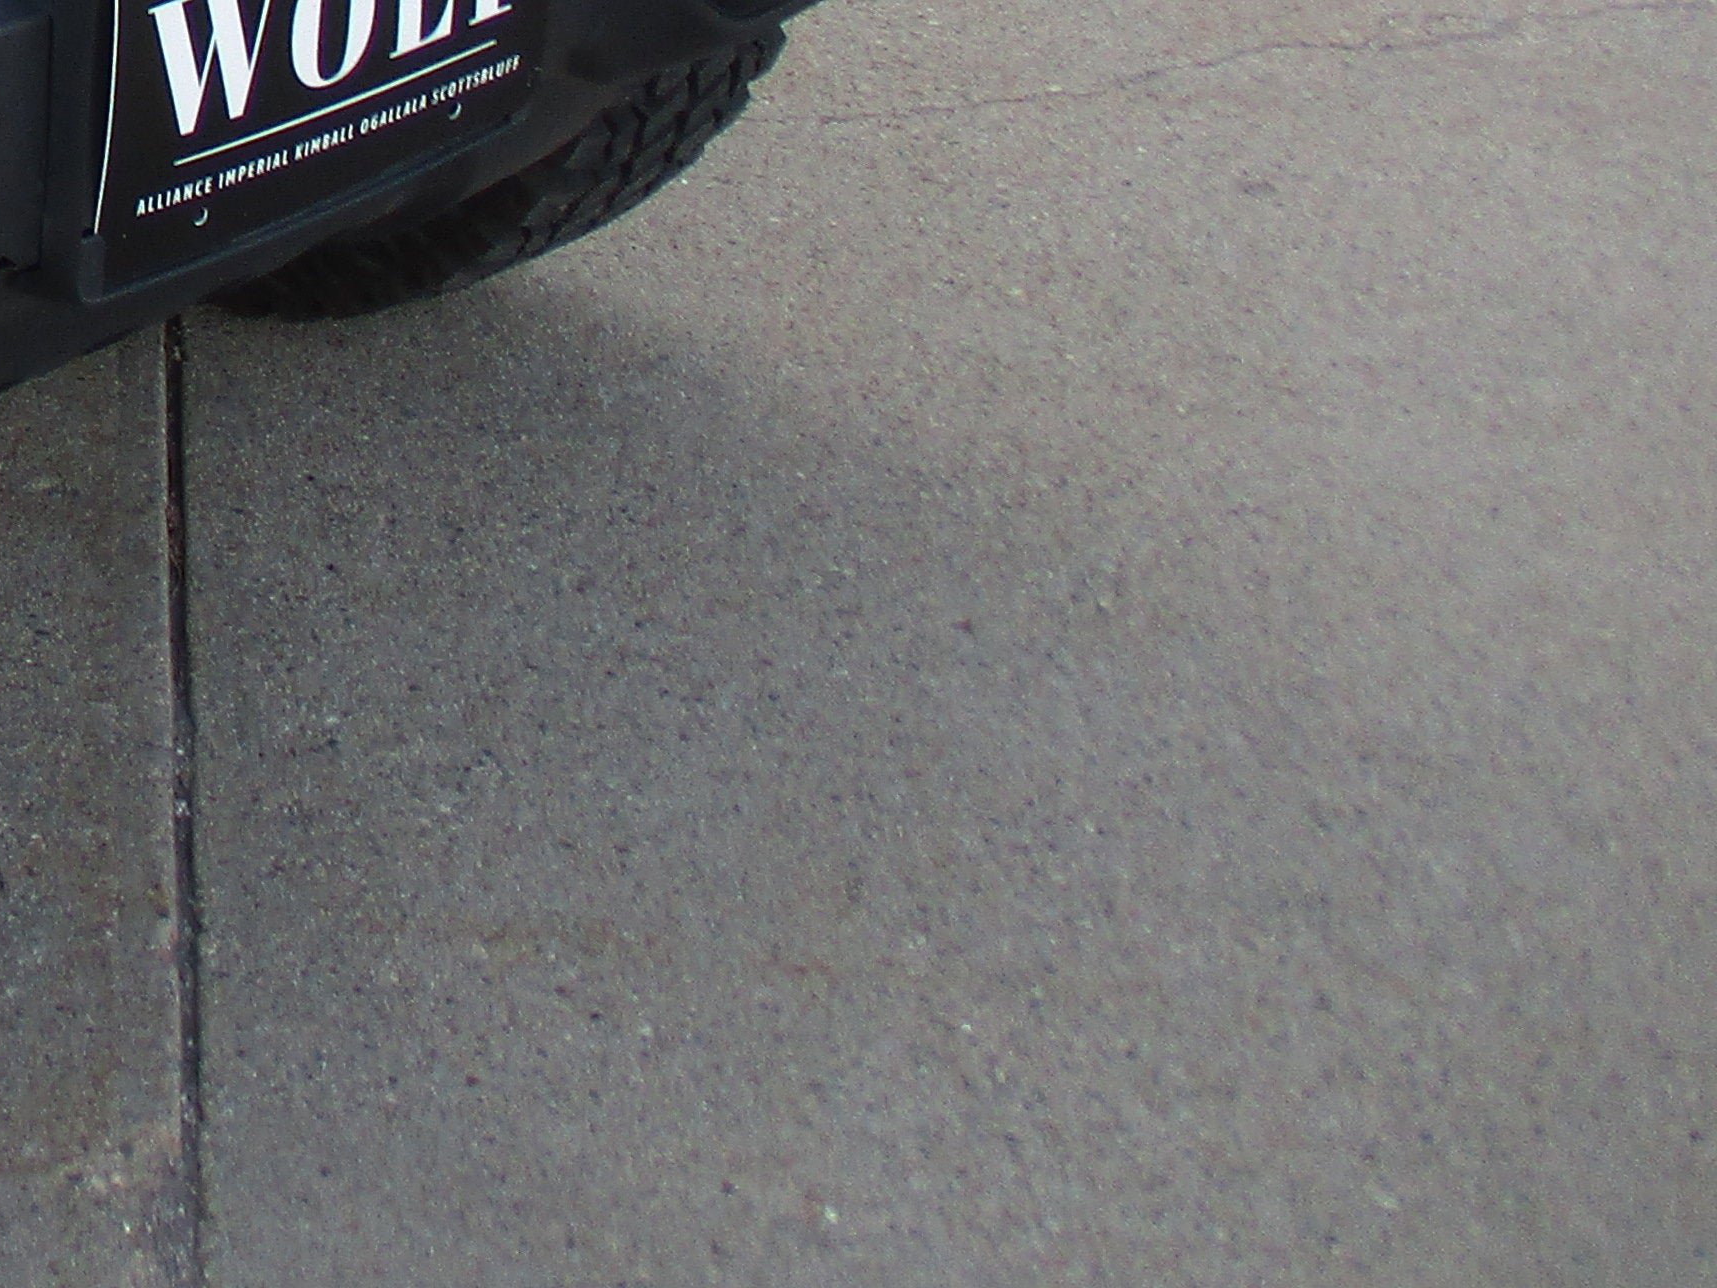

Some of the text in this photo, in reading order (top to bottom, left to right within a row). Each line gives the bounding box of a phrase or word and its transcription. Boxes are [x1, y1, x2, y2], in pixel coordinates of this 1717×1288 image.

[136, 54, 521, 217] ALLIANCE IMPERIAL KIMBALL OGALLALA SCOTTSBLUFF
